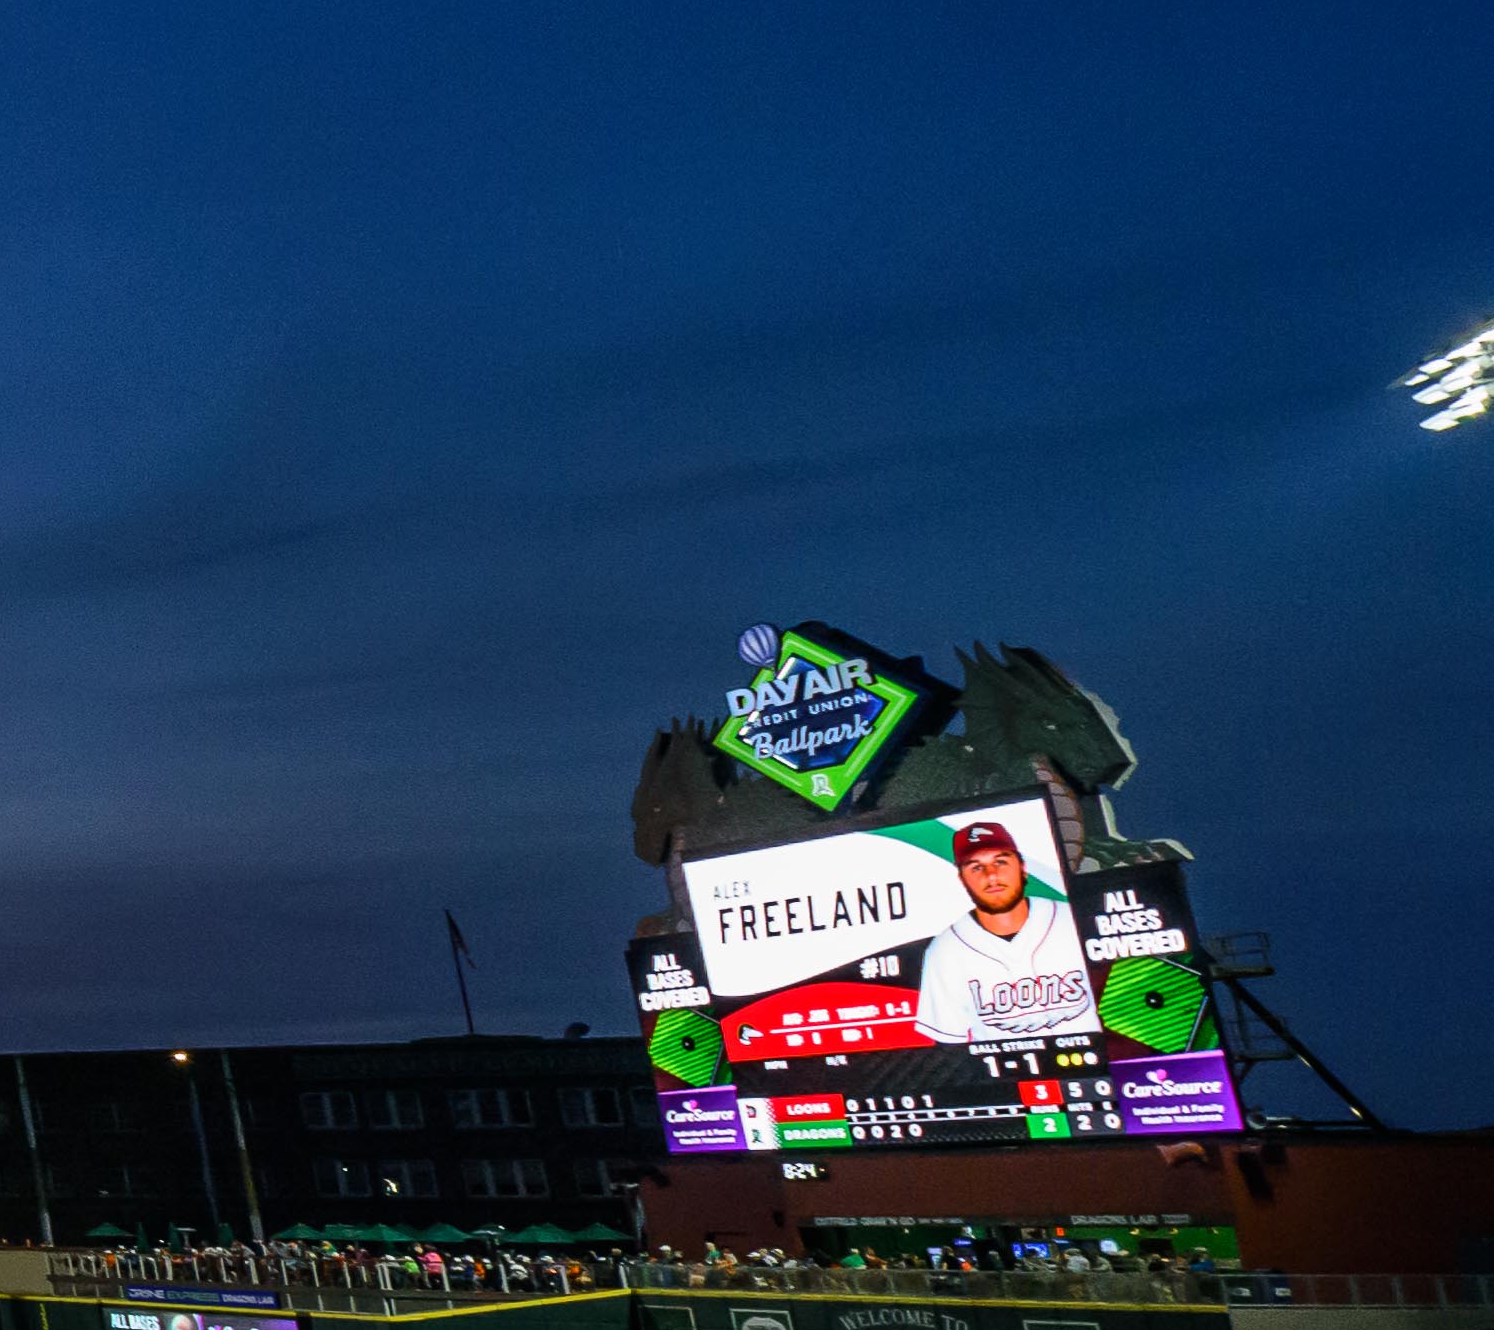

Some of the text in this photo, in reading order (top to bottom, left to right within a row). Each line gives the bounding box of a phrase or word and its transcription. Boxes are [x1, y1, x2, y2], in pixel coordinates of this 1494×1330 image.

[726, 659, 872, 717] DAY AIR
[808, 692, 869, 715] UNION
[750, 714, 873, 760] Ballpark
[718, 881, 908, 945] FREELAND
[1104, 890, 1145, 912] ALL
[1096, 909, 1163, 936] BASES
[1085, 929, 1187, 960] COVERED
[652, 953, 681, 971] ALL
[860, 955, 901, 979] #10
[646, 969, 694, 991] BASES
[639, 986, 710, 1011] COVERED
[969, 970, 1086, 1016] Loons
[969, 1036, 1090, 1054] BALL STRIKE OUTS
[786, 1080, 1110, 1115] LOONS 0 1 1 0 1 3 5 0
[1122, 1079, 1223, 1098] CareSource
[666, 1108, 736, 1123] CareSource
[783, 1113, 1120, 1141] DRAGONS 0 0 2 0 2 2 0
[110, 1313, 129, 1330] ALL
[839, 1308, 936, 1330] WELCOME
